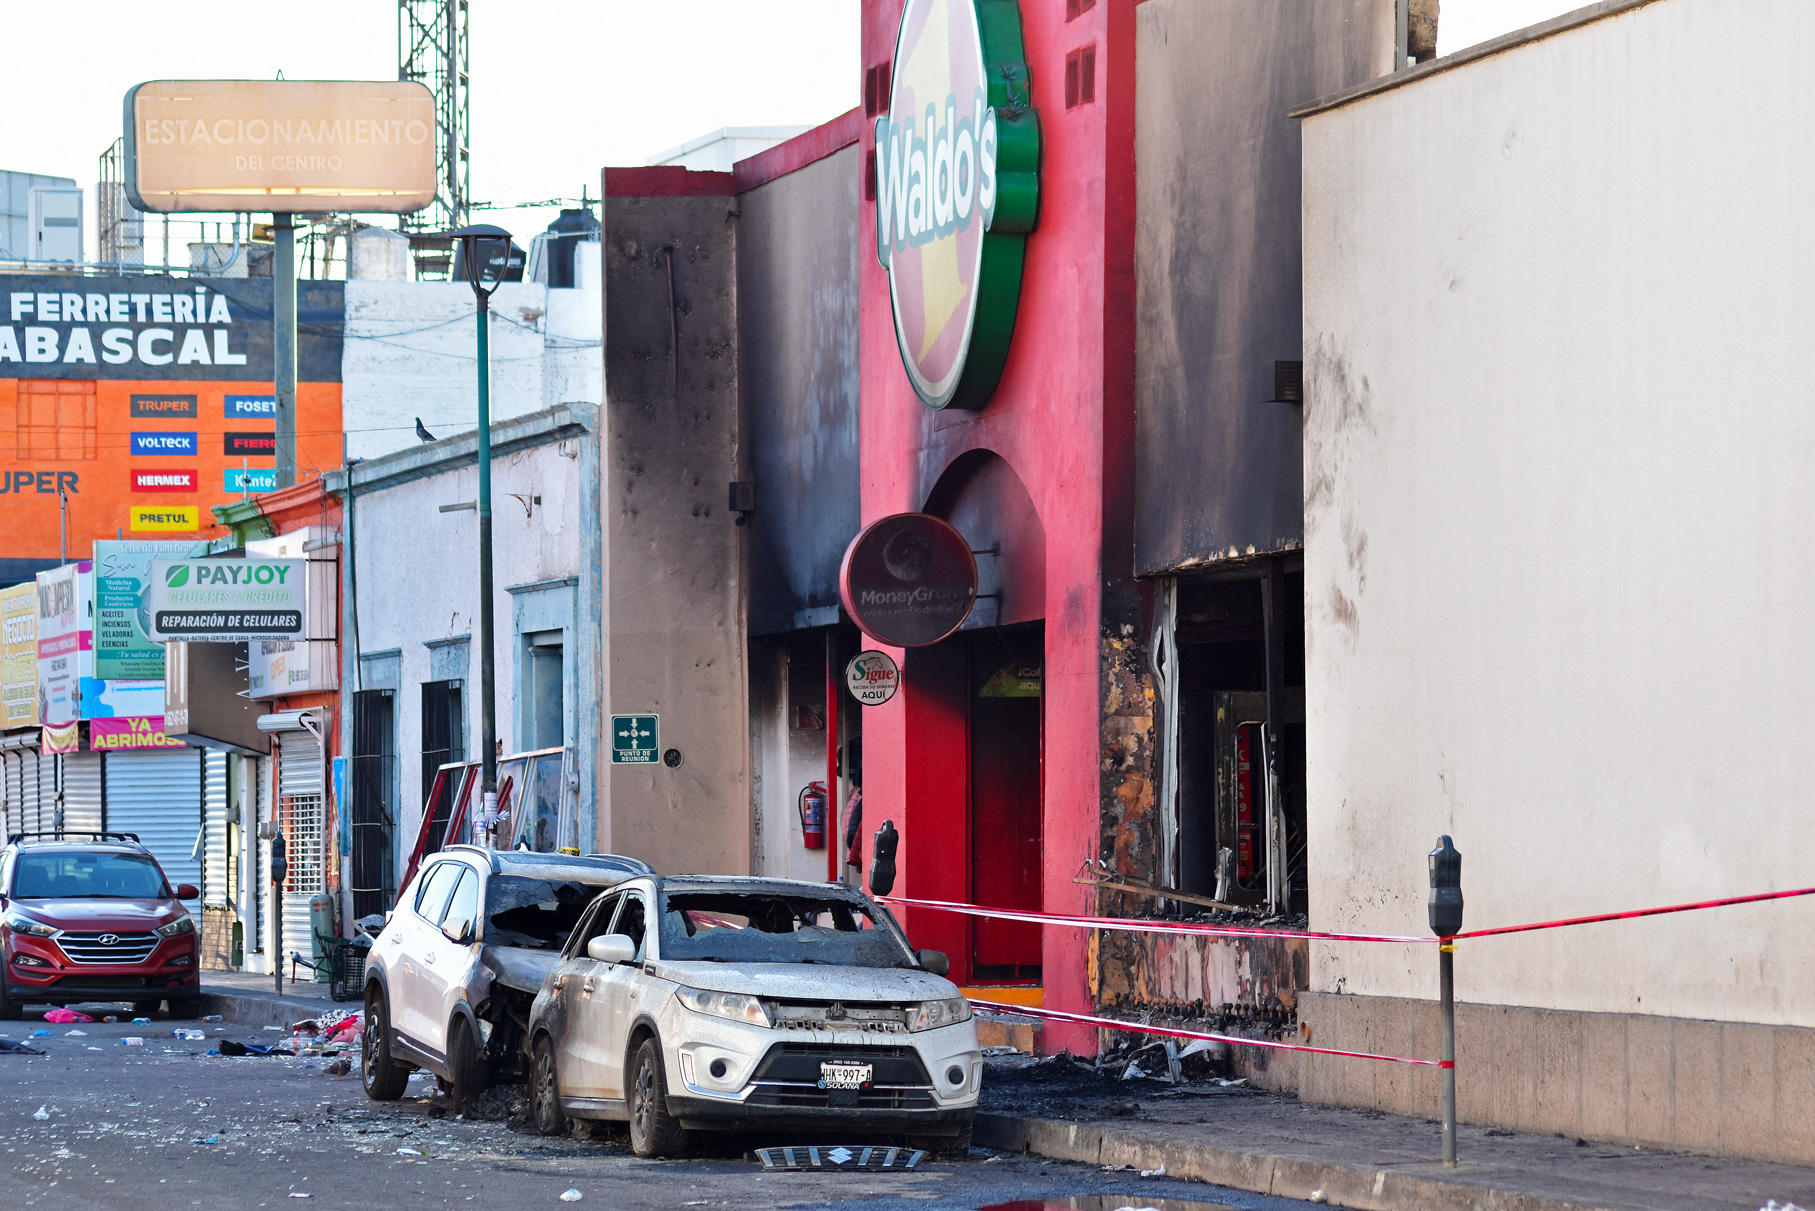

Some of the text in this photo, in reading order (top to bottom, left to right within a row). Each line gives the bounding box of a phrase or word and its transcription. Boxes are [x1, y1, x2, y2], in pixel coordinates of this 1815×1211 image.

[145, 119, 429, 144] ESTACIONAMIENTO
[235, 155, 343, 171] DEL CENTRO
[876, 98, 996, 246] Waldo's
[10, 286, 232, 324] FERRETERÍA
[137, 401, 189, 411] TRUPER
[137, 475, 190, 486] HERMEX
[140, 513, 189, 523] PRETUL
[196, 565, 291, 585] PAYJOY
[169, 588, 292, 604] CELULARES A CRÉDITO
[161, 612, 297, 627] REPARACIÓN DE CELULARES
[852, 659, 894, 684] Sigue
[861, 689, 886, 699] AQUÍ
[1019, 681, 1040, 692] aqu
[126, 718, 152, 732] YA
